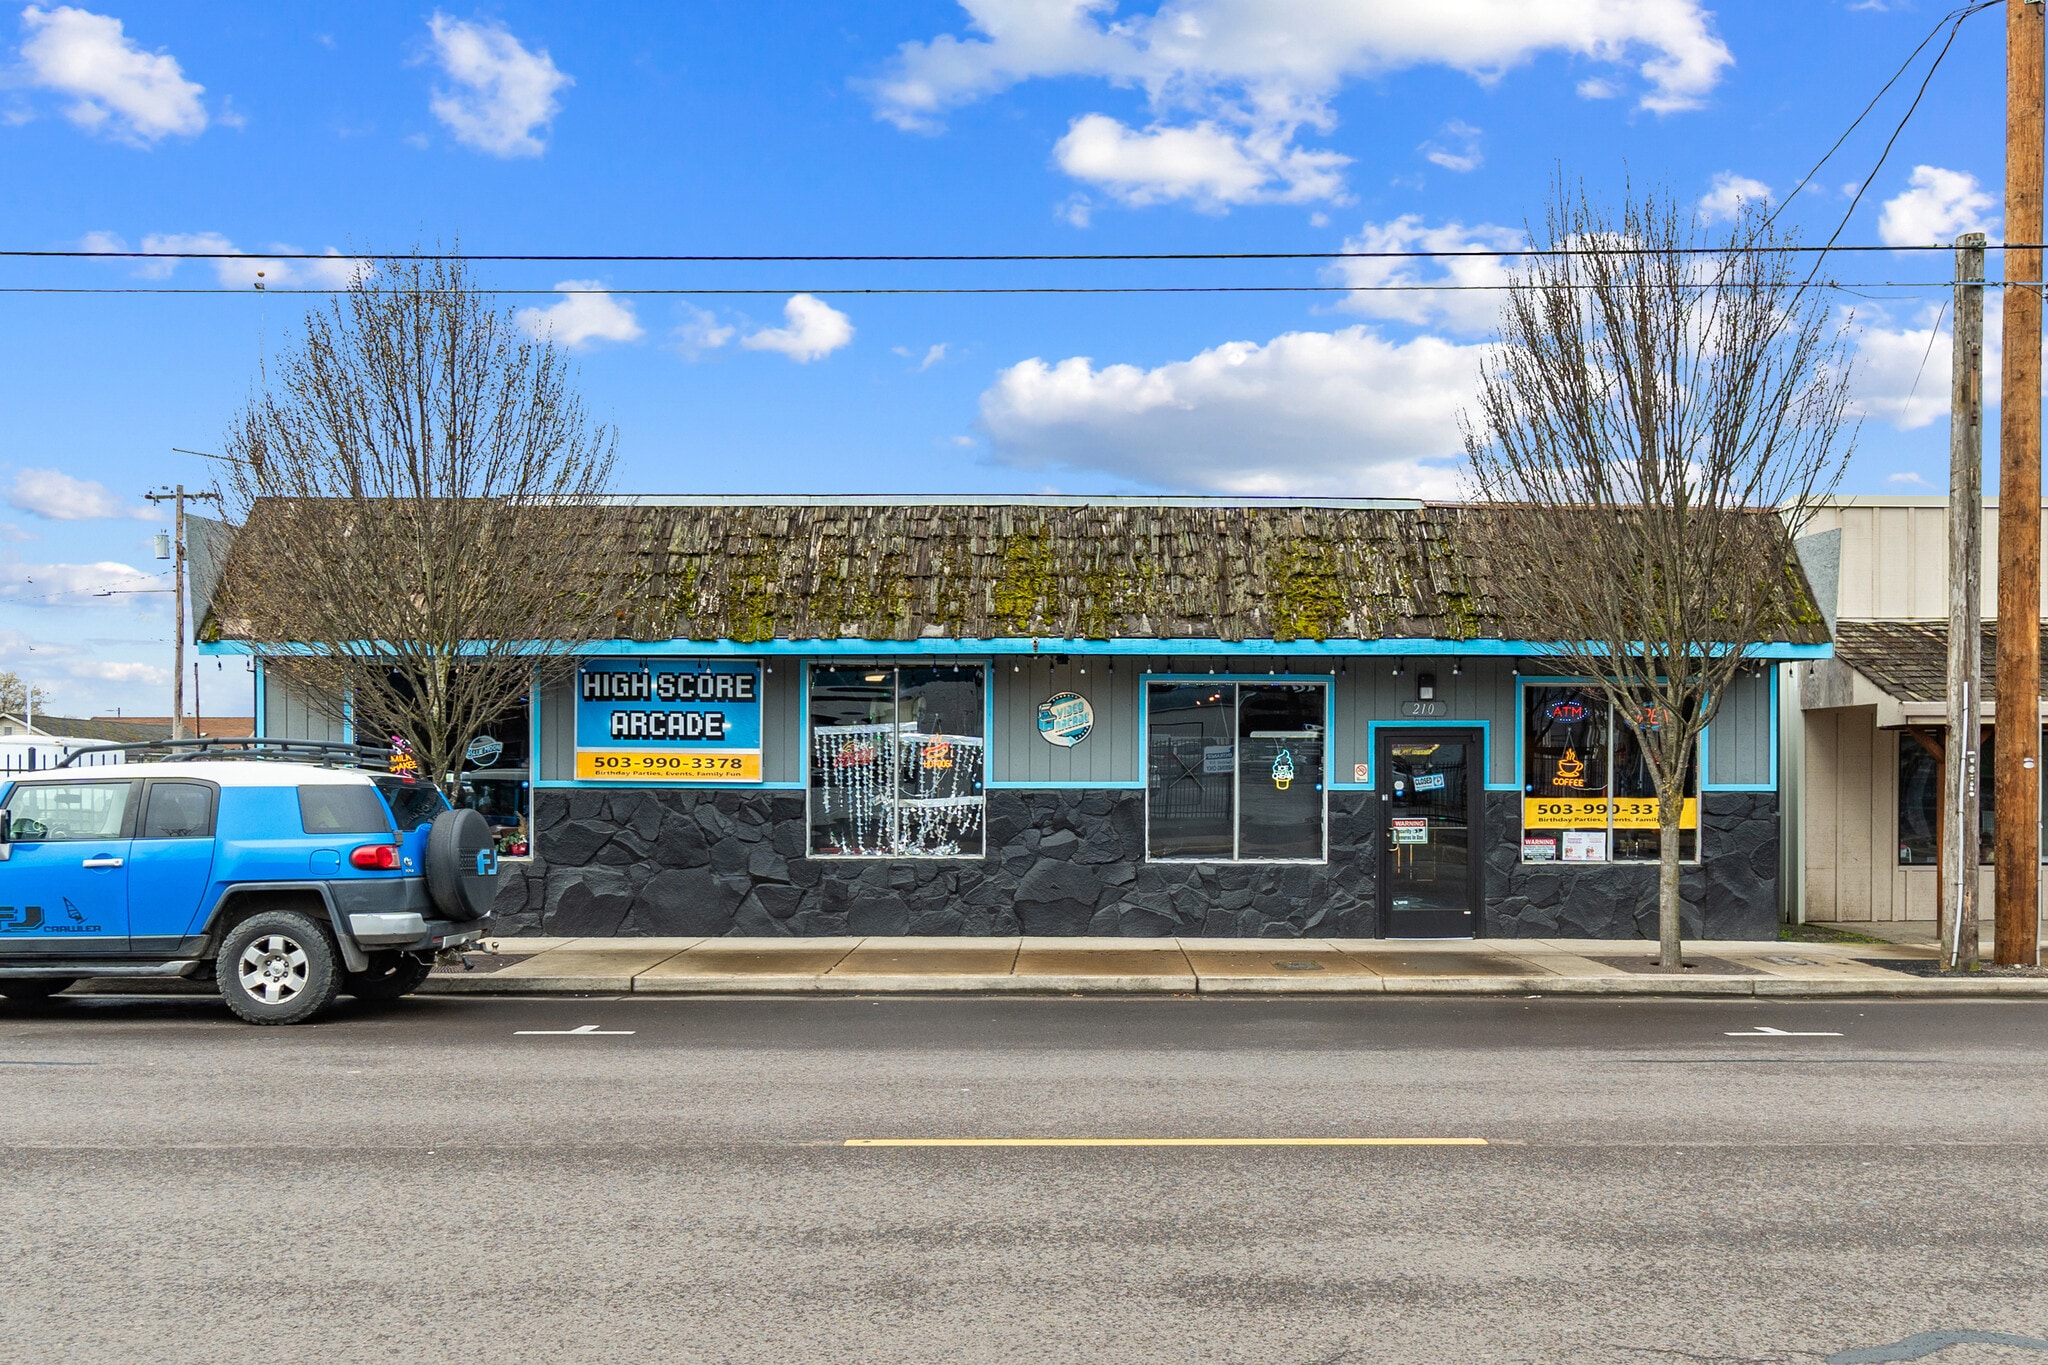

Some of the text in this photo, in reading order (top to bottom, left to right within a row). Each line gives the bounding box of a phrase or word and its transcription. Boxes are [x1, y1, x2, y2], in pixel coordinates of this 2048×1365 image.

[583, 673, 753, 699] HIGH SCORE
[1412, 703, 1435, 715] 210
[1552, 706, 1583, 717] ATM
[612, 712, 723, 738] ARCADE
[390, 754, 412, 762] MILK
[594, 756, 743, 769] 503-990-3378
[1272, 771, 1294, 780] CREAM
[1415, 776, 1432, 786] CLOSED
[1552, 777, 1585, 787] COFFEE
[1537, 803, 1660, 815] 503-990-33
[476, 848, 498, 876] FJ
[43, 925, 102, 933] CRAWLER
